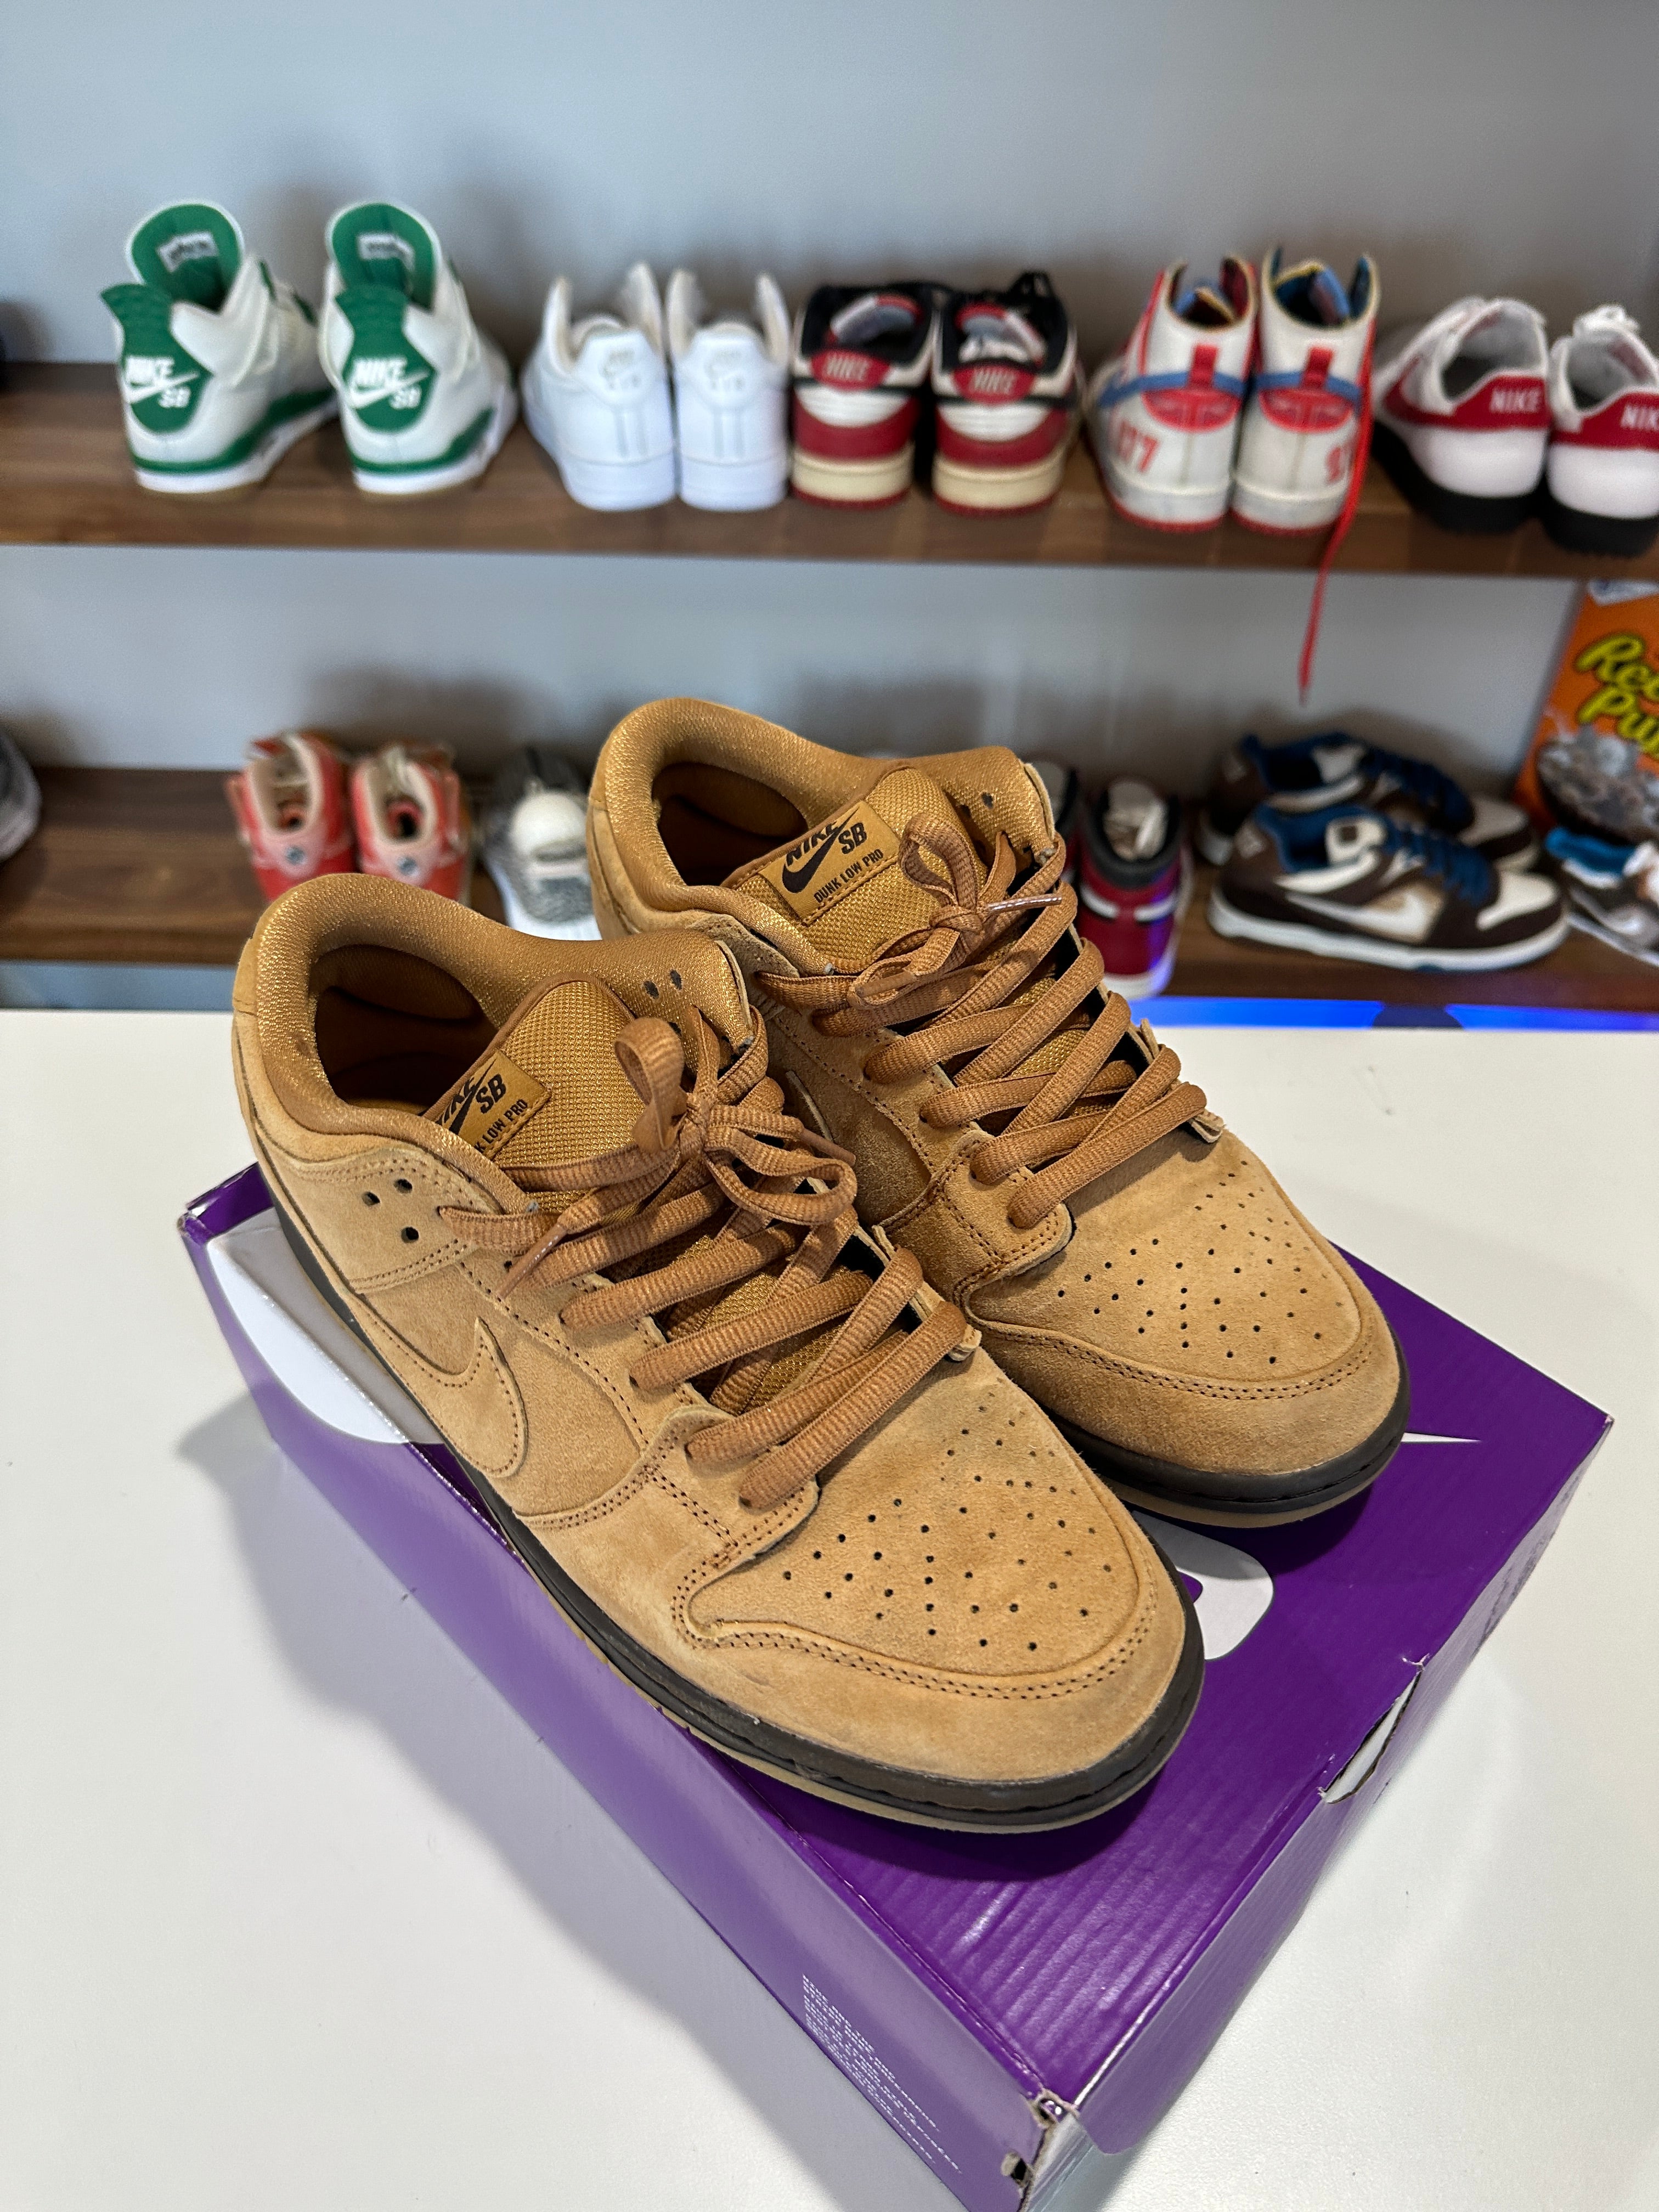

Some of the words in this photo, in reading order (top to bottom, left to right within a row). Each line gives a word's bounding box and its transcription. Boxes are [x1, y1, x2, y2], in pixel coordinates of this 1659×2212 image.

[822, 353, 870, 382] NIKE
[1489, 387, 1541, 413] NIKE
[1620, 404, 1659, 430] NIK
[786, 821, 839, 867] NIKE
[838, 822, 867, 854] SB
[813, 878, 842, 903] DUNK
[839, 861, 862, 883] LOW
[862, 849, 883, 867] PRO
[476, 1074, 506, 1114] SB
[482, 1118, 506, 1144] LOW
[504, 1099, 528, 1121] PRO
